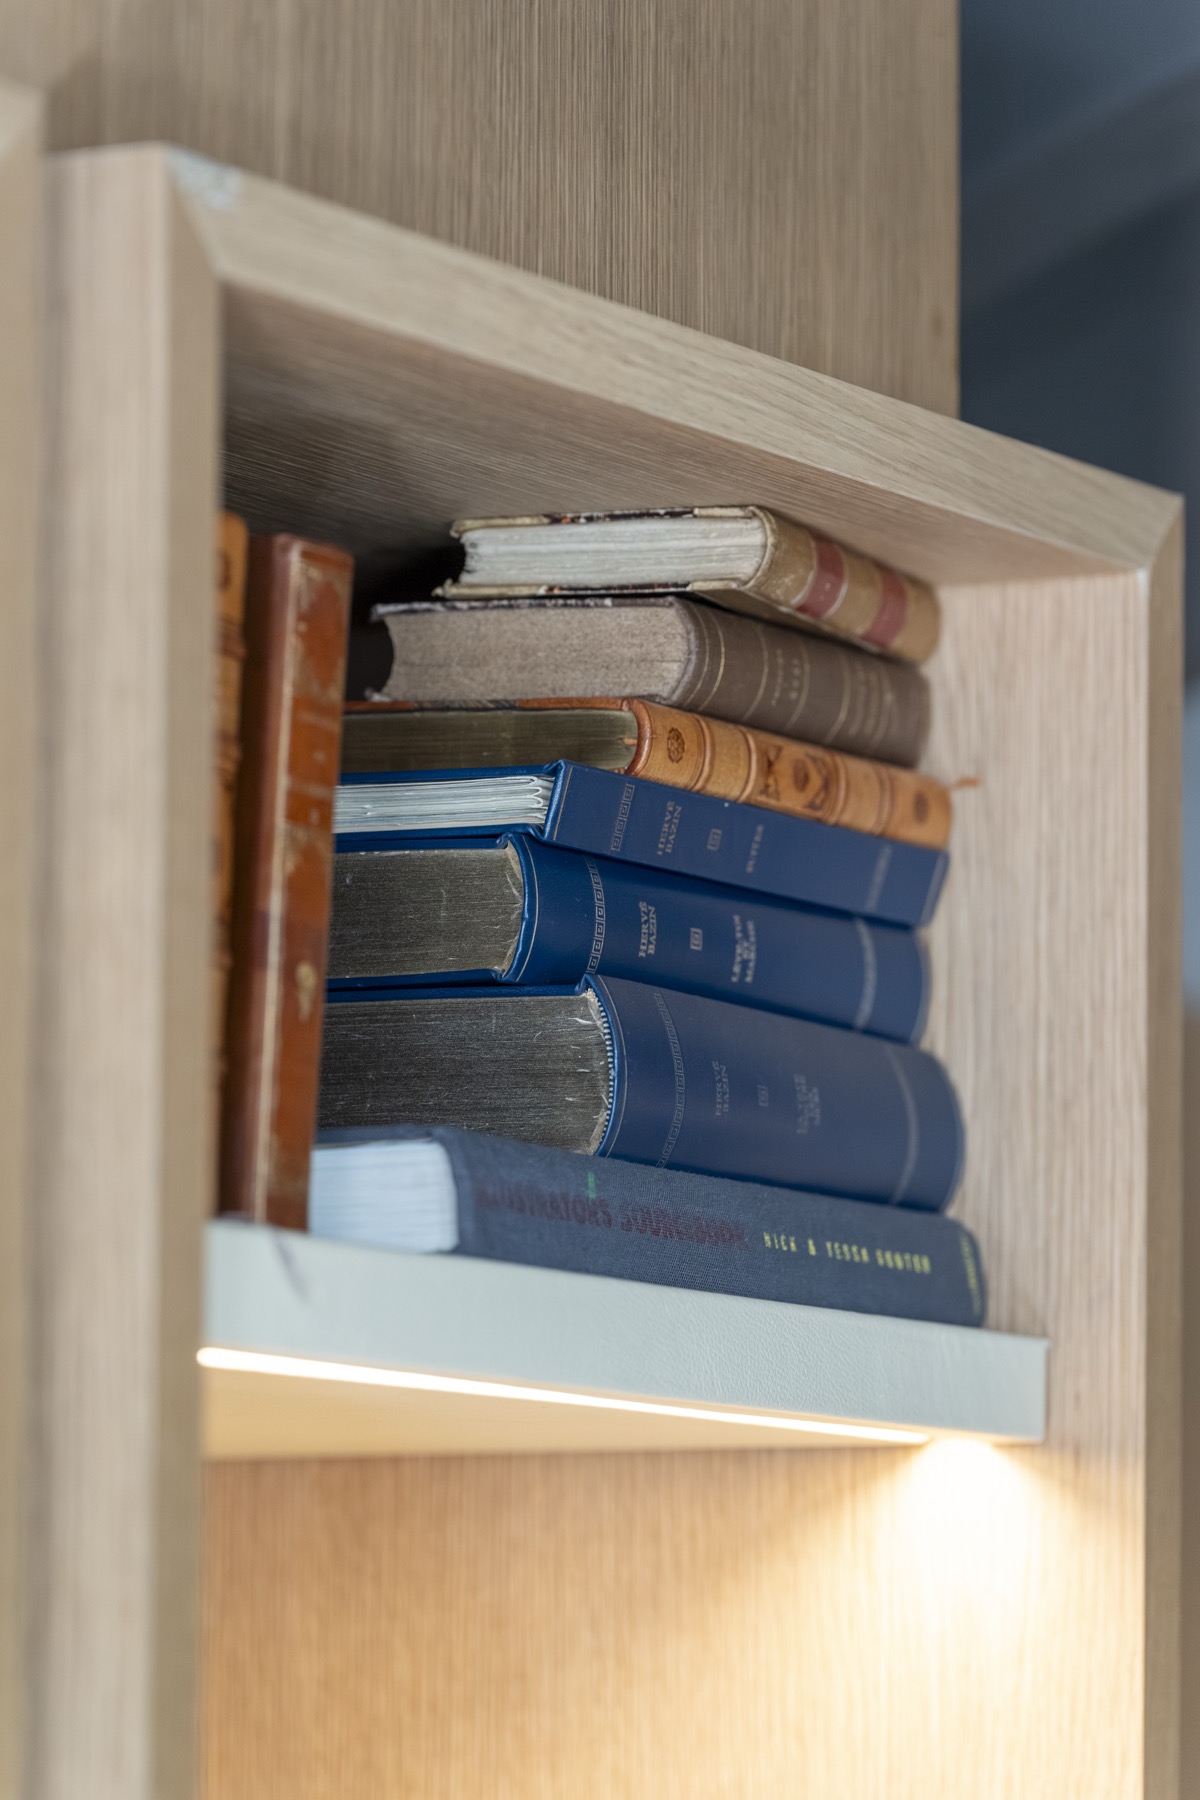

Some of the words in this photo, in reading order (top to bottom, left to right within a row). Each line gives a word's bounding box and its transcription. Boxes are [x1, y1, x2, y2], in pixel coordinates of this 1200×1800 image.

[665, 805, 682, 853] BAZIN
[647, 905, 657, 955] BAZIN
[720, 1064, 730, 1113] BAZIN
[763, 1231, 797, 1252] NICK
[825, 1241, 869, 1264] TESSA
